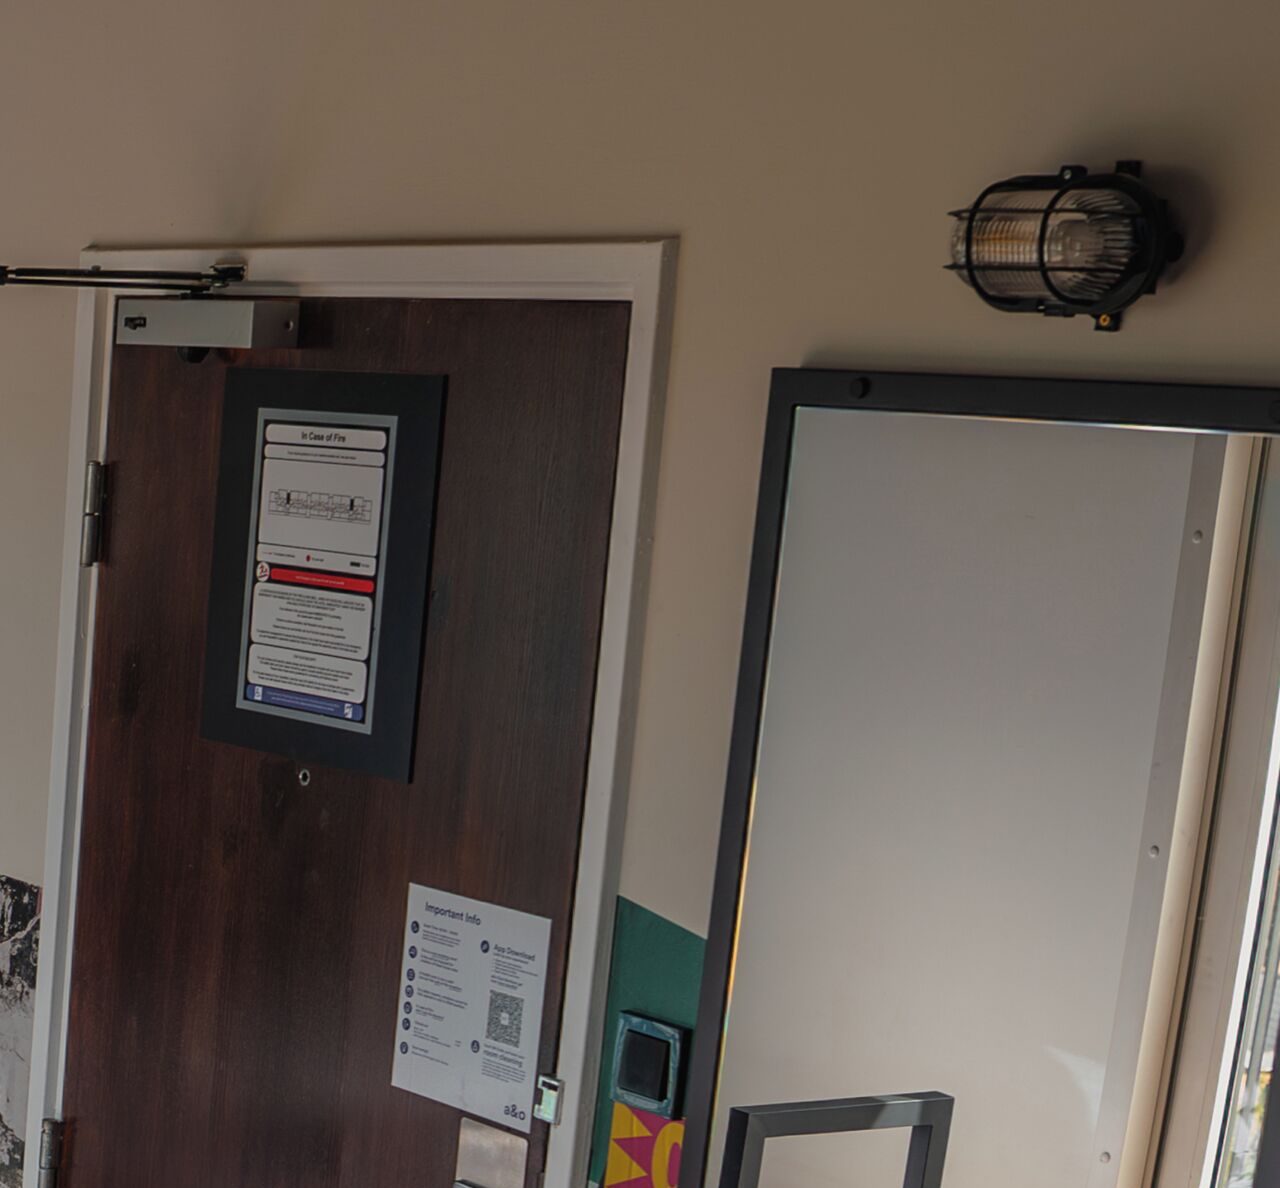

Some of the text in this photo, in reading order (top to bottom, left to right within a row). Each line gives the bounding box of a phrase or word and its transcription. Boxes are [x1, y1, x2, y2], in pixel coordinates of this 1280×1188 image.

[308, 431, 324, 441] Case
[333, 433, 347, 443] Fire
[424, 901, 482, 926] Important Info
[504, 1103, 526, 1121] a&o
